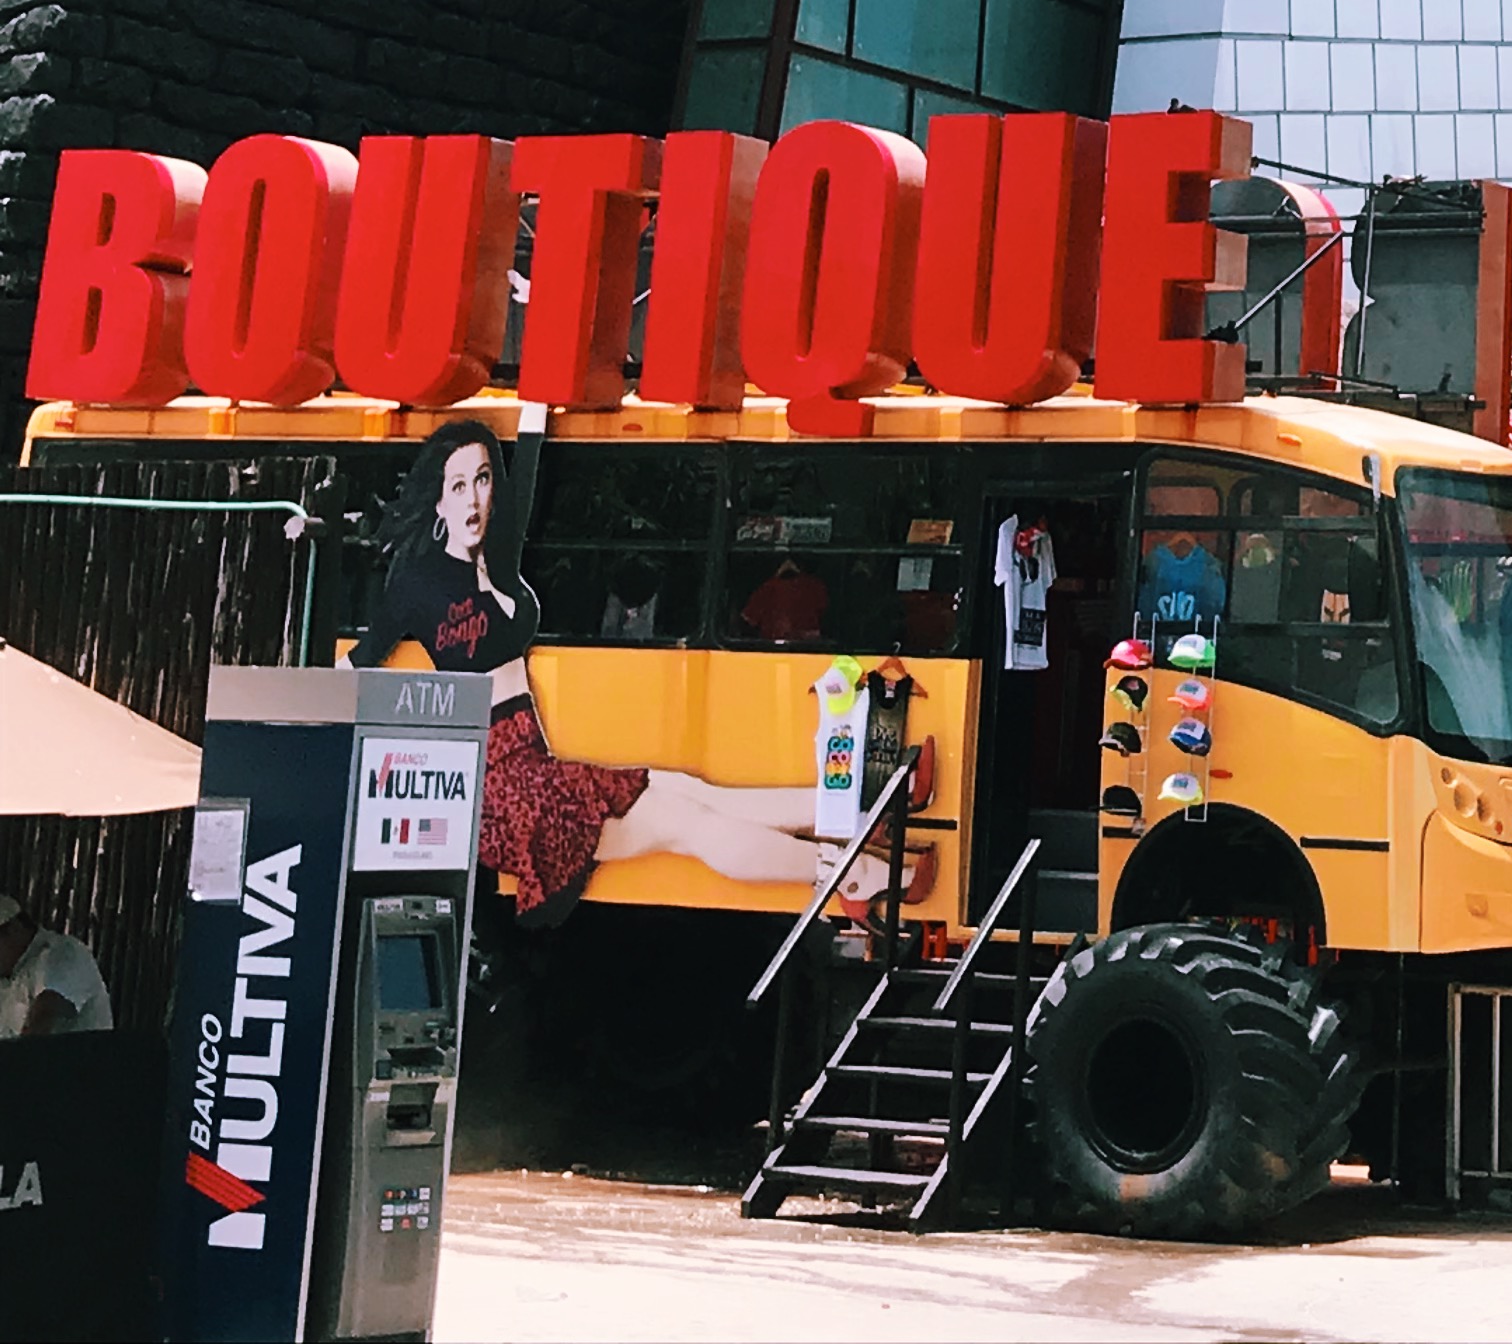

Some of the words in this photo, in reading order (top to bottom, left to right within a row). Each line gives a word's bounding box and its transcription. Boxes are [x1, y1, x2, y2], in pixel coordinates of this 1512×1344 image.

[26, 110, 1252, 438] BOUTIQUE
[395, 681, 455, 716] ATM
[368, 767, 467, 801] MULTIVA
[190, 1013, 222, 1150] BANCO
[206, 844, 302, 1249] MULTIVA
